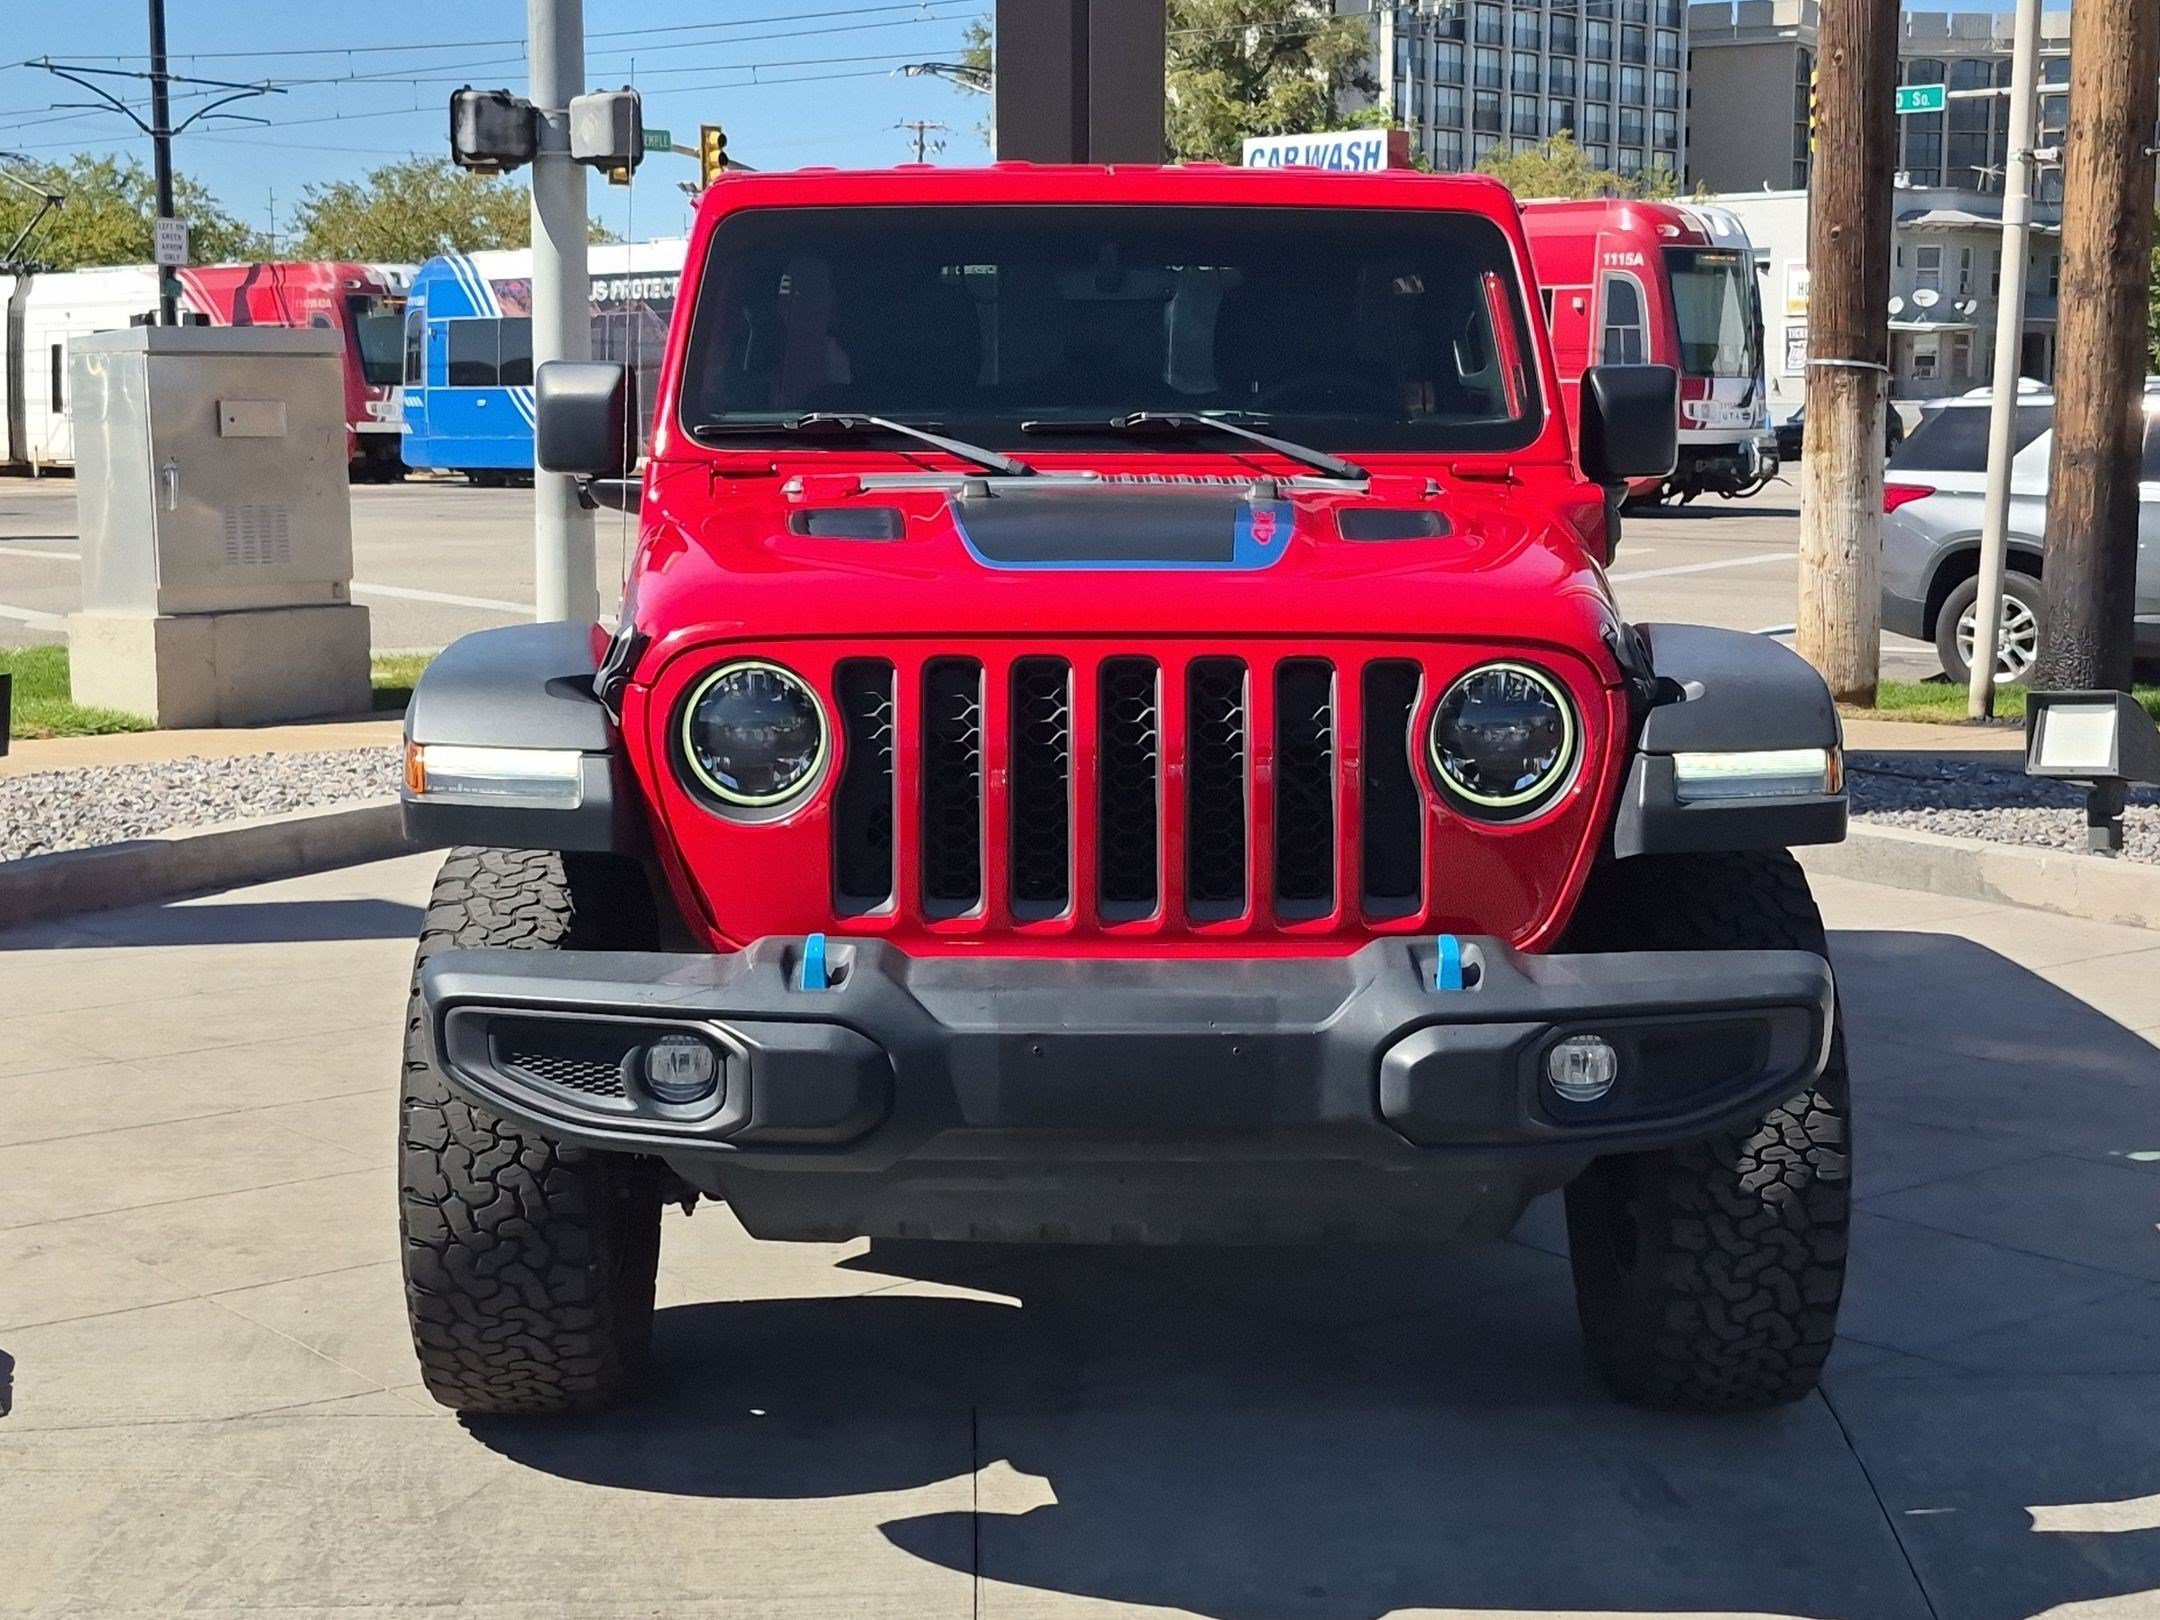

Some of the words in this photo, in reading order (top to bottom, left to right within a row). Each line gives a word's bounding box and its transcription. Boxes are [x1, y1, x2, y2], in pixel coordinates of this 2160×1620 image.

[1250, 146, 1299, 168] CAR
[1305, 140, 1383, 171] WASH
[1603, 252, 1645, 267] 1115A
